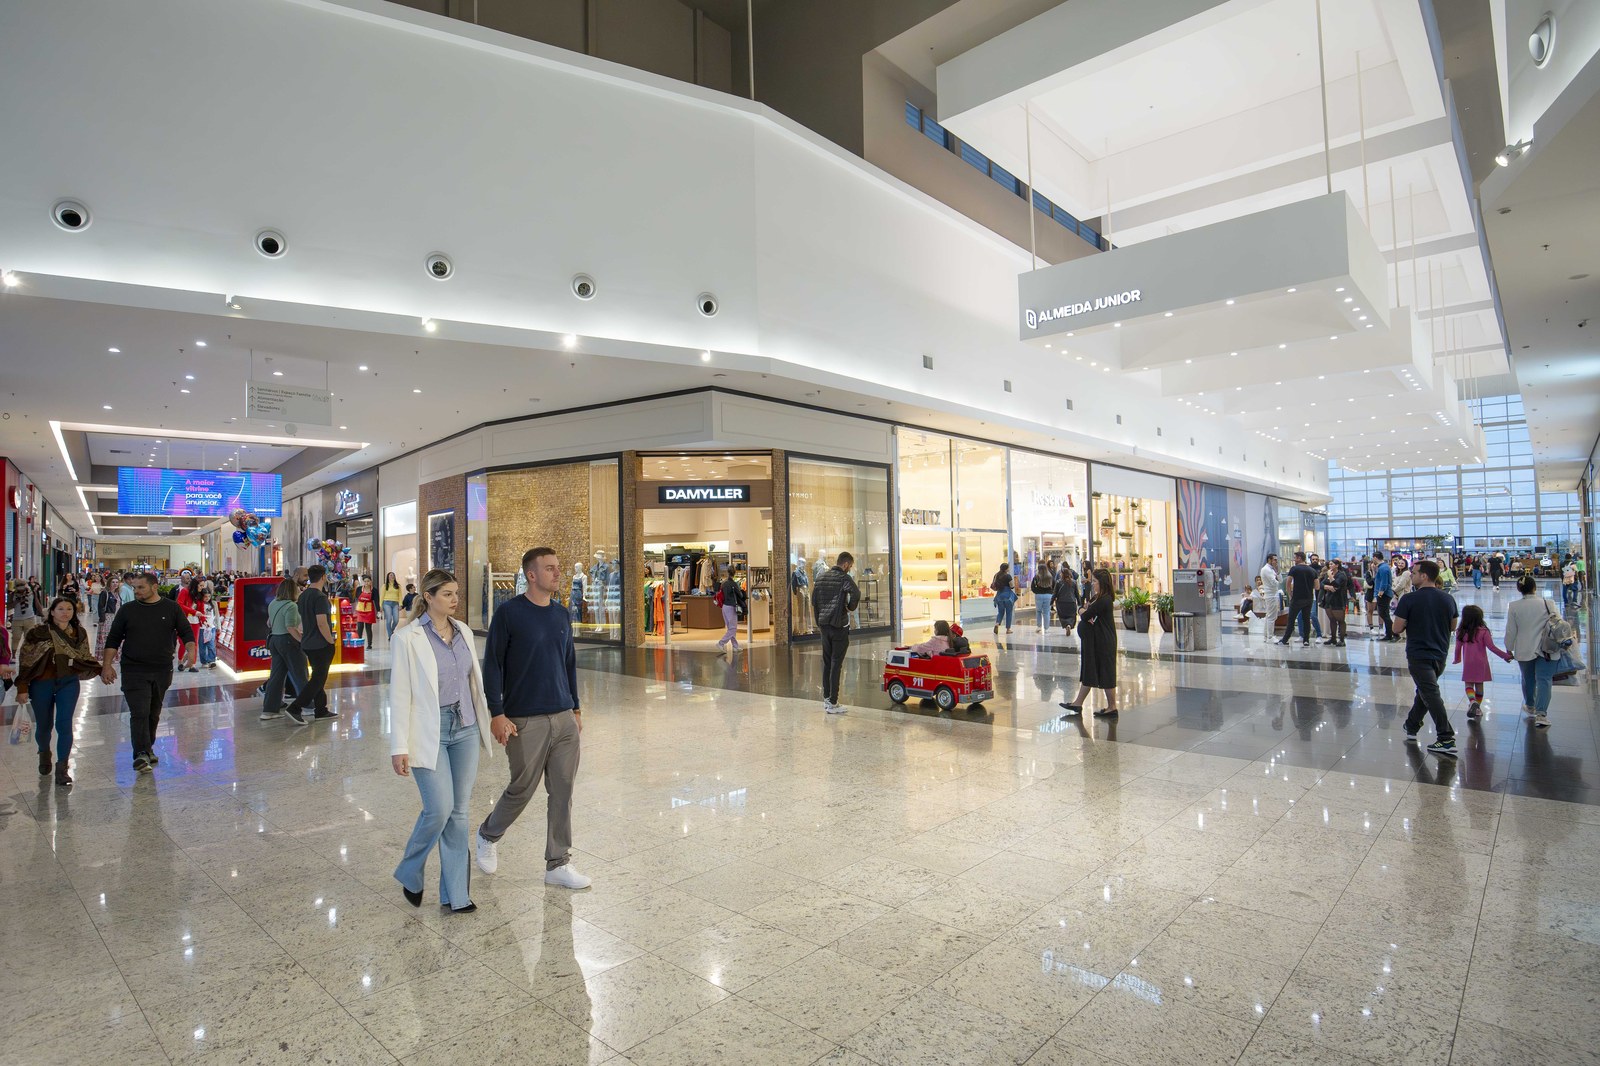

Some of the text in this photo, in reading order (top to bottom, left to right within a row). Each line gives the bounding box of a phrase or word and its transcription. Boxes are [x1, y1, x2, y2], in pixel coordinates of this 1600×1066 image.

[1038, 289, 1142, 323] ALMEIDA JUNIOR
[205, 491, 223, 500] você
[665, 488, 744, 500] DAMYLLER
[912, 676, 924, 687] 911
